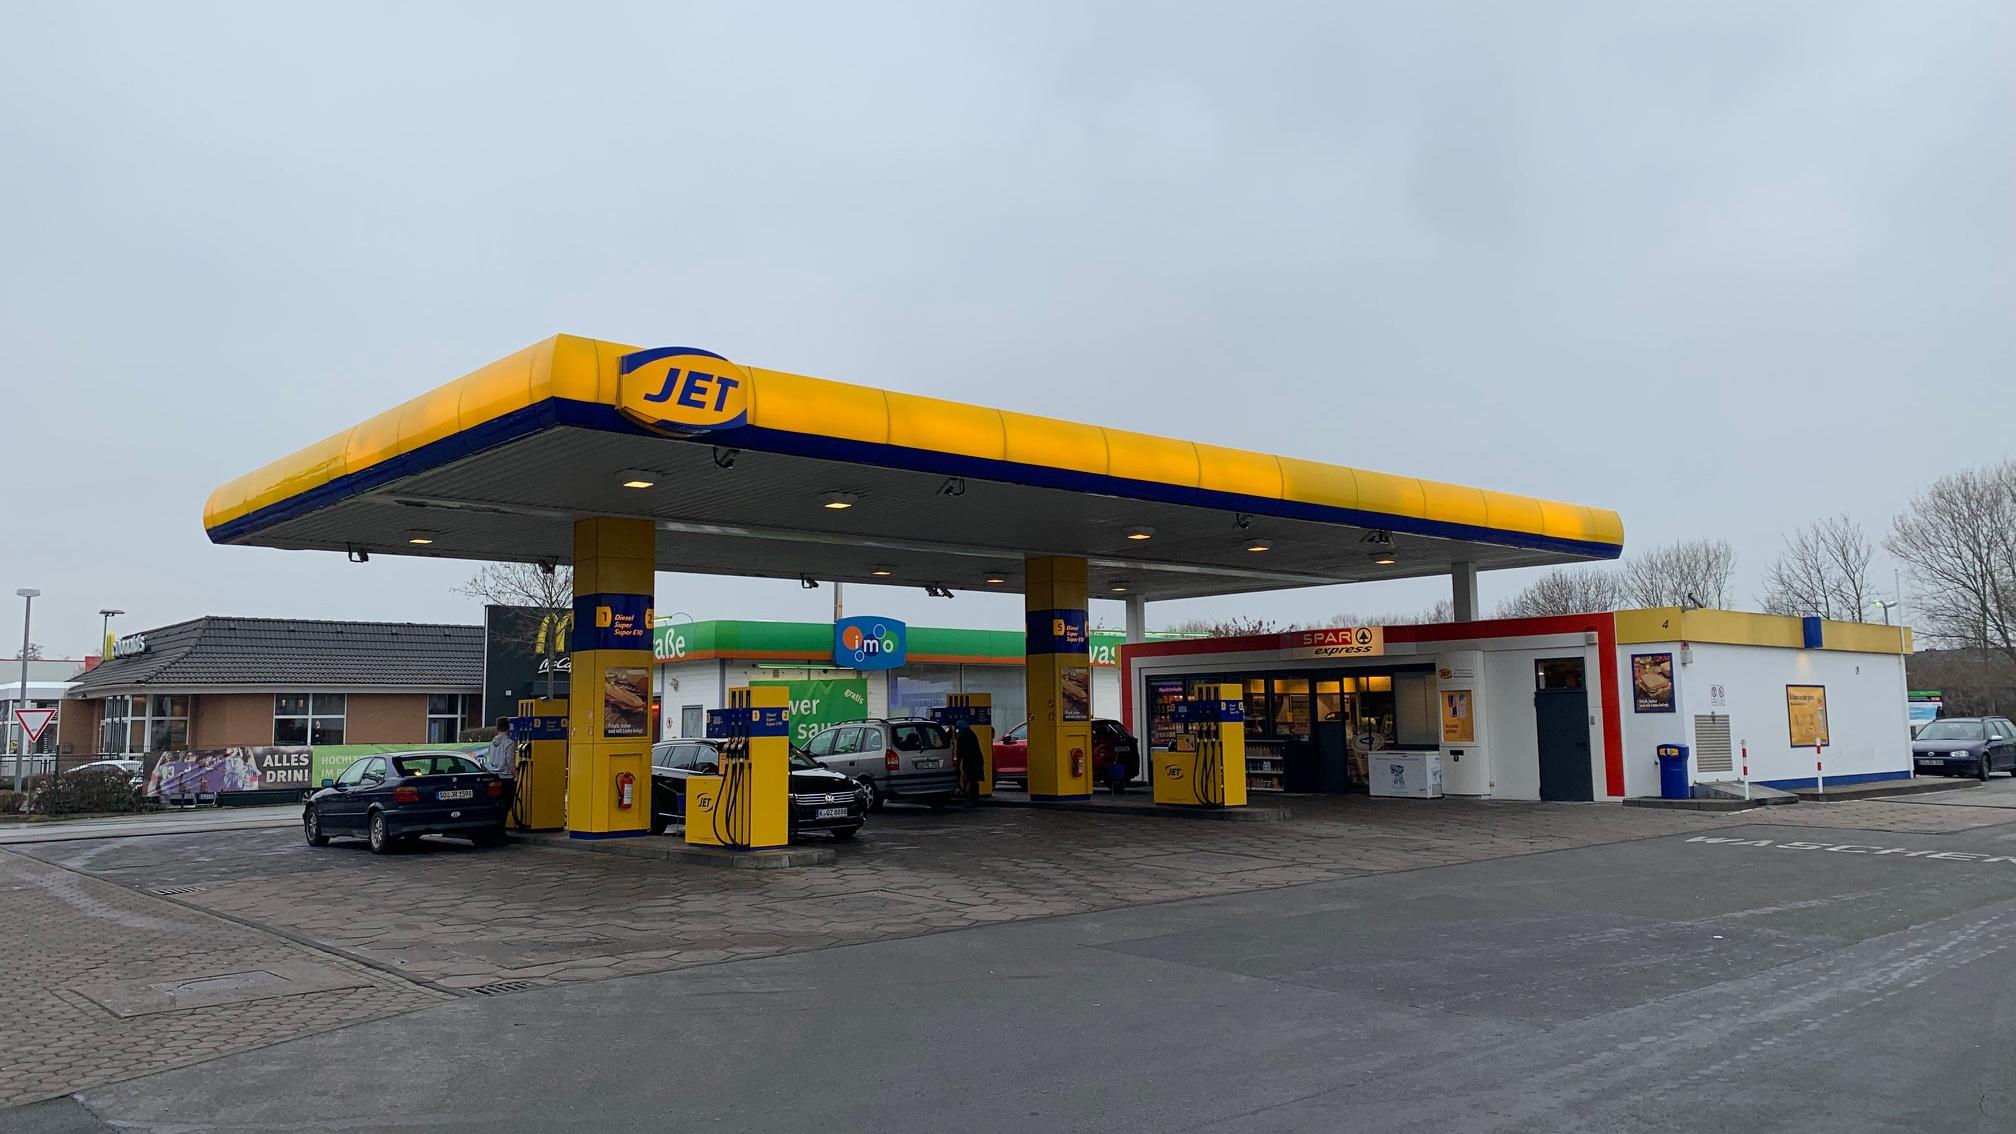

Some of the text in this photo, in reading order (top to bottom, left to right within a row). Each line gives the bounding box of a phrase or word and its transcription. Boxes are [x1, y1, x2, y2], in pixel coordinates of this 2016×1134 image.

[643, 368, 739, 412] JET
[614, 621, 633, 629] Super
[1662, 619, 1669, 629] 4
[614, 629, 632, 637] Super
[1303, 632, 1351, 645] SPAR
[654, 628, 686, 660] aße
[854, 635, 894, 653] imo
[1315, 645, 1373, 656] express
[844, 688, 865, 705] gratis
[263, 754, 309, 767] ALLES
[266, 769, 309, 783] DRIN!
[698, 797, 711, 808] JET
